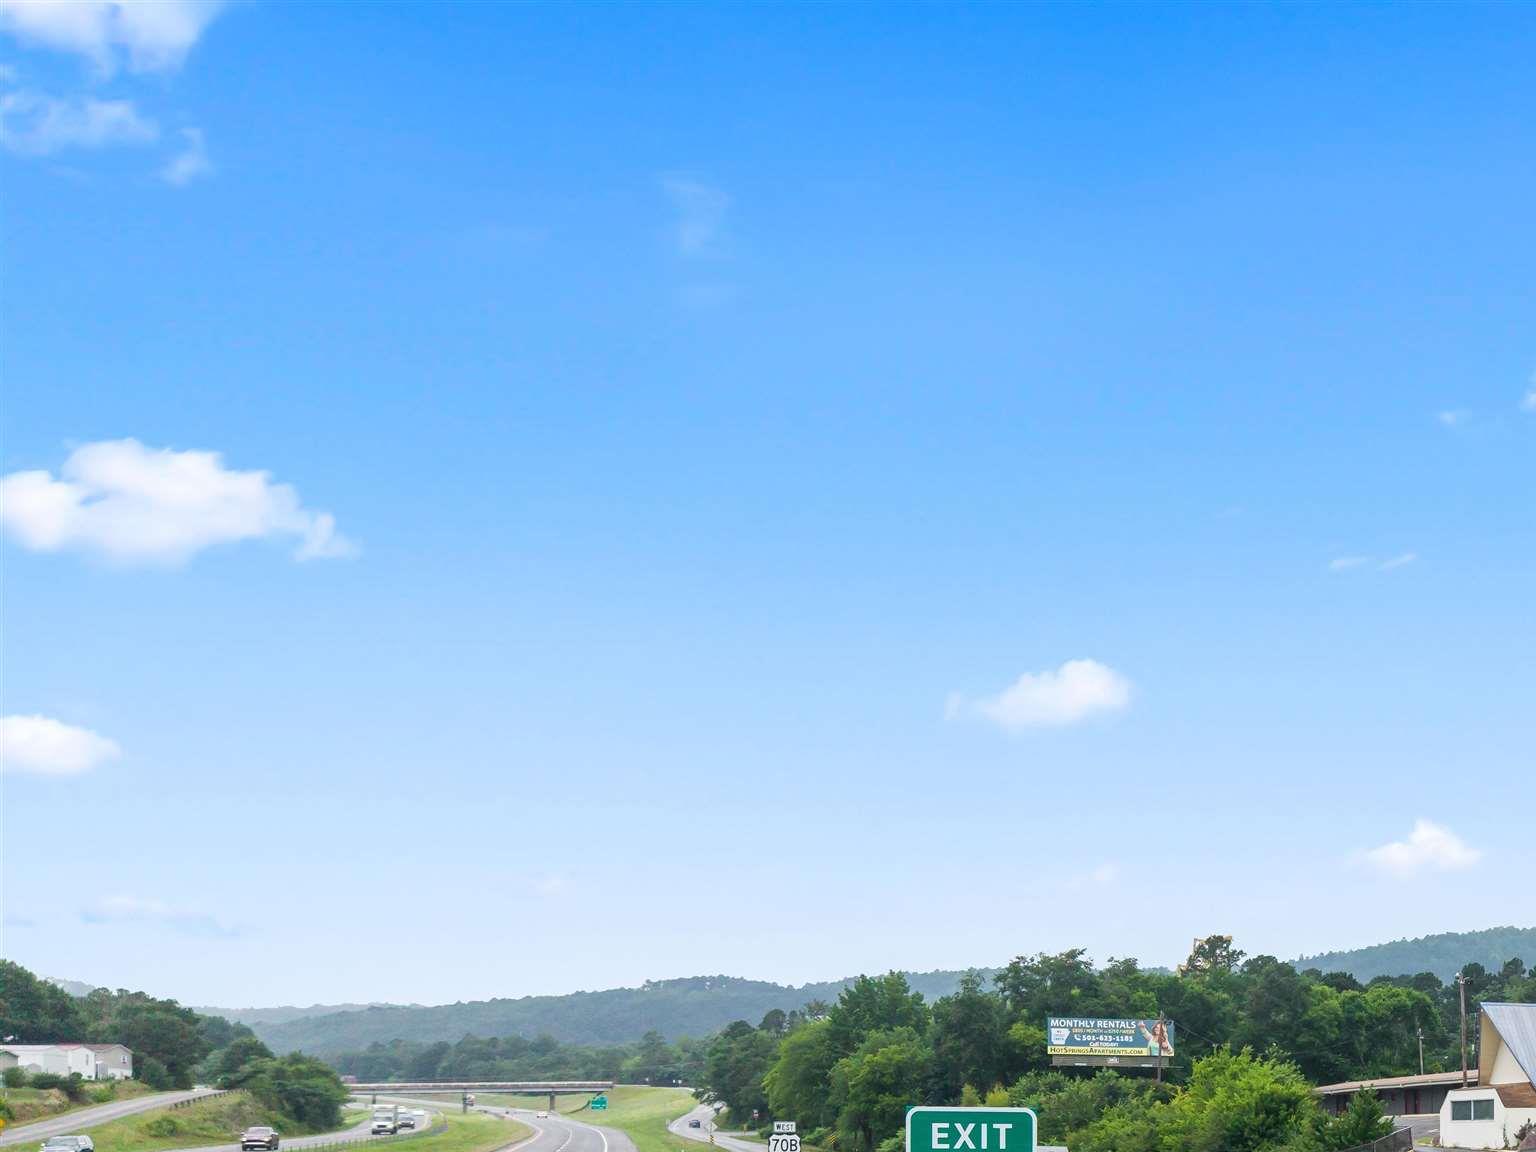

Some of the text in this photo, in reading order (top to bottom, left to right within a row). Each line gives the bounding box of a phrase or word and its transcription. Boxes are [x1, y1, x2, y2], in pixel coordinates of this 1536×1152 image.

[1050, 1019, 1136, 1029] MONTHLY RENTALS
[776, 1123, 794, 1131] WEST
[931, 1122, 1013, 1150] EXIT
[772, 1138, 798, 1152] 70B
